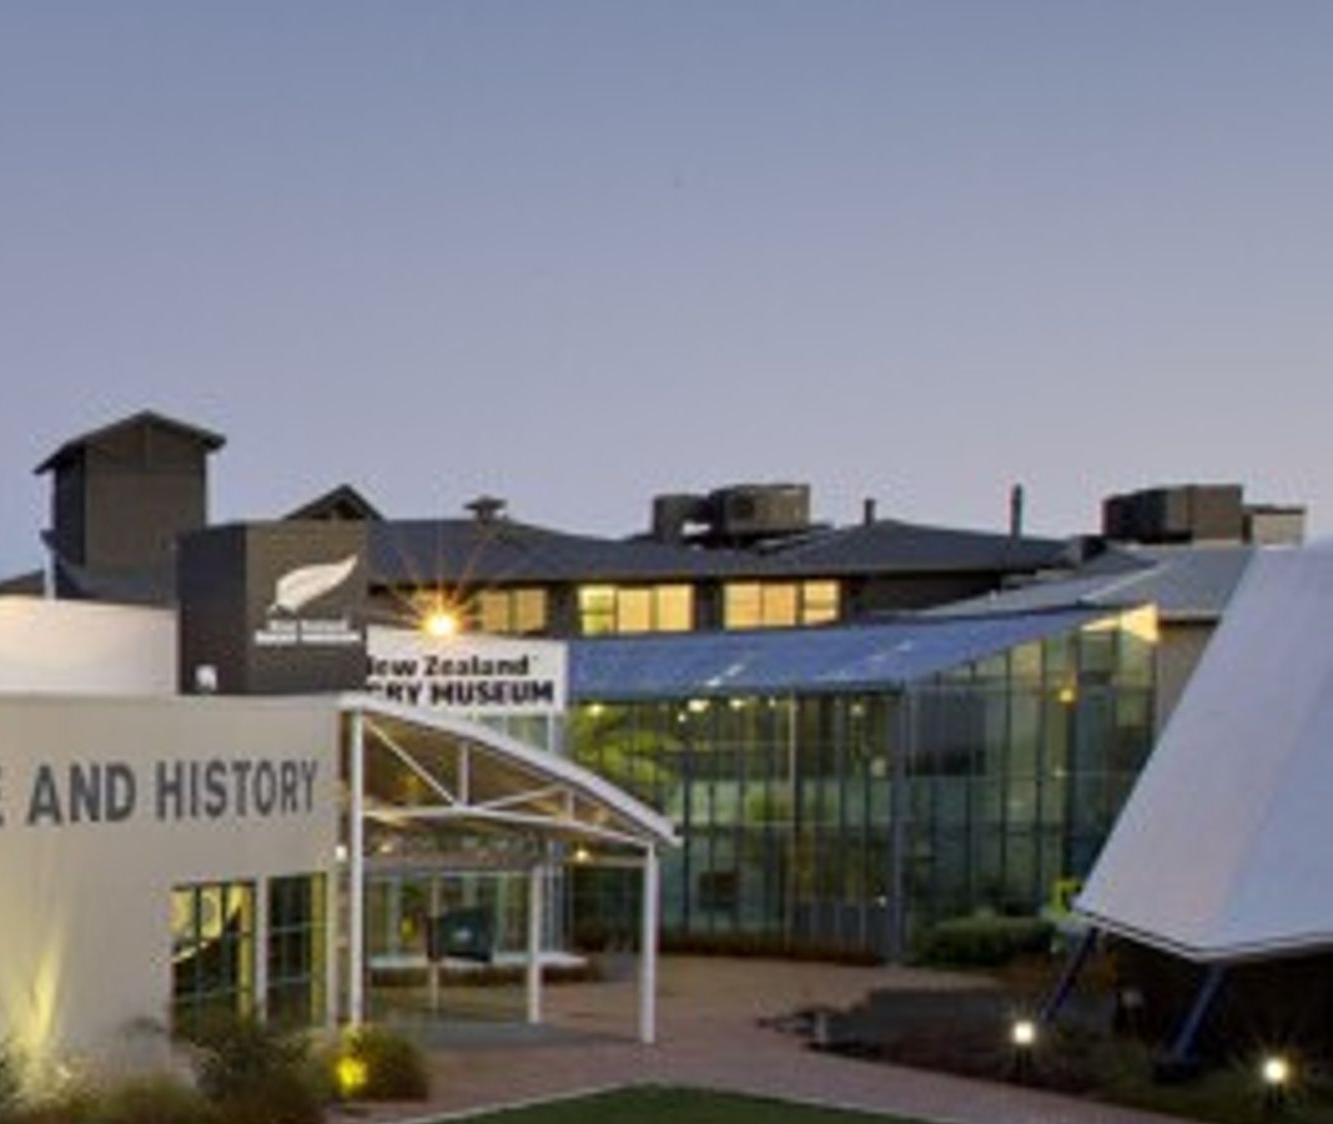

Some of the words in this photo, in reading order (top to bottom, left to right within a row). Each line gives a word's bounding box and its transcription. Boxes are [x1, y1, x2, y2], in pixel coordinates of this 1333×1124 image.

[424, 655, 529, 677] Zealand
[430, 681, 555, 706] MUSEUM
[27, 762, 137, 827] AND
[154, 759, 320, 822] HISTORY
